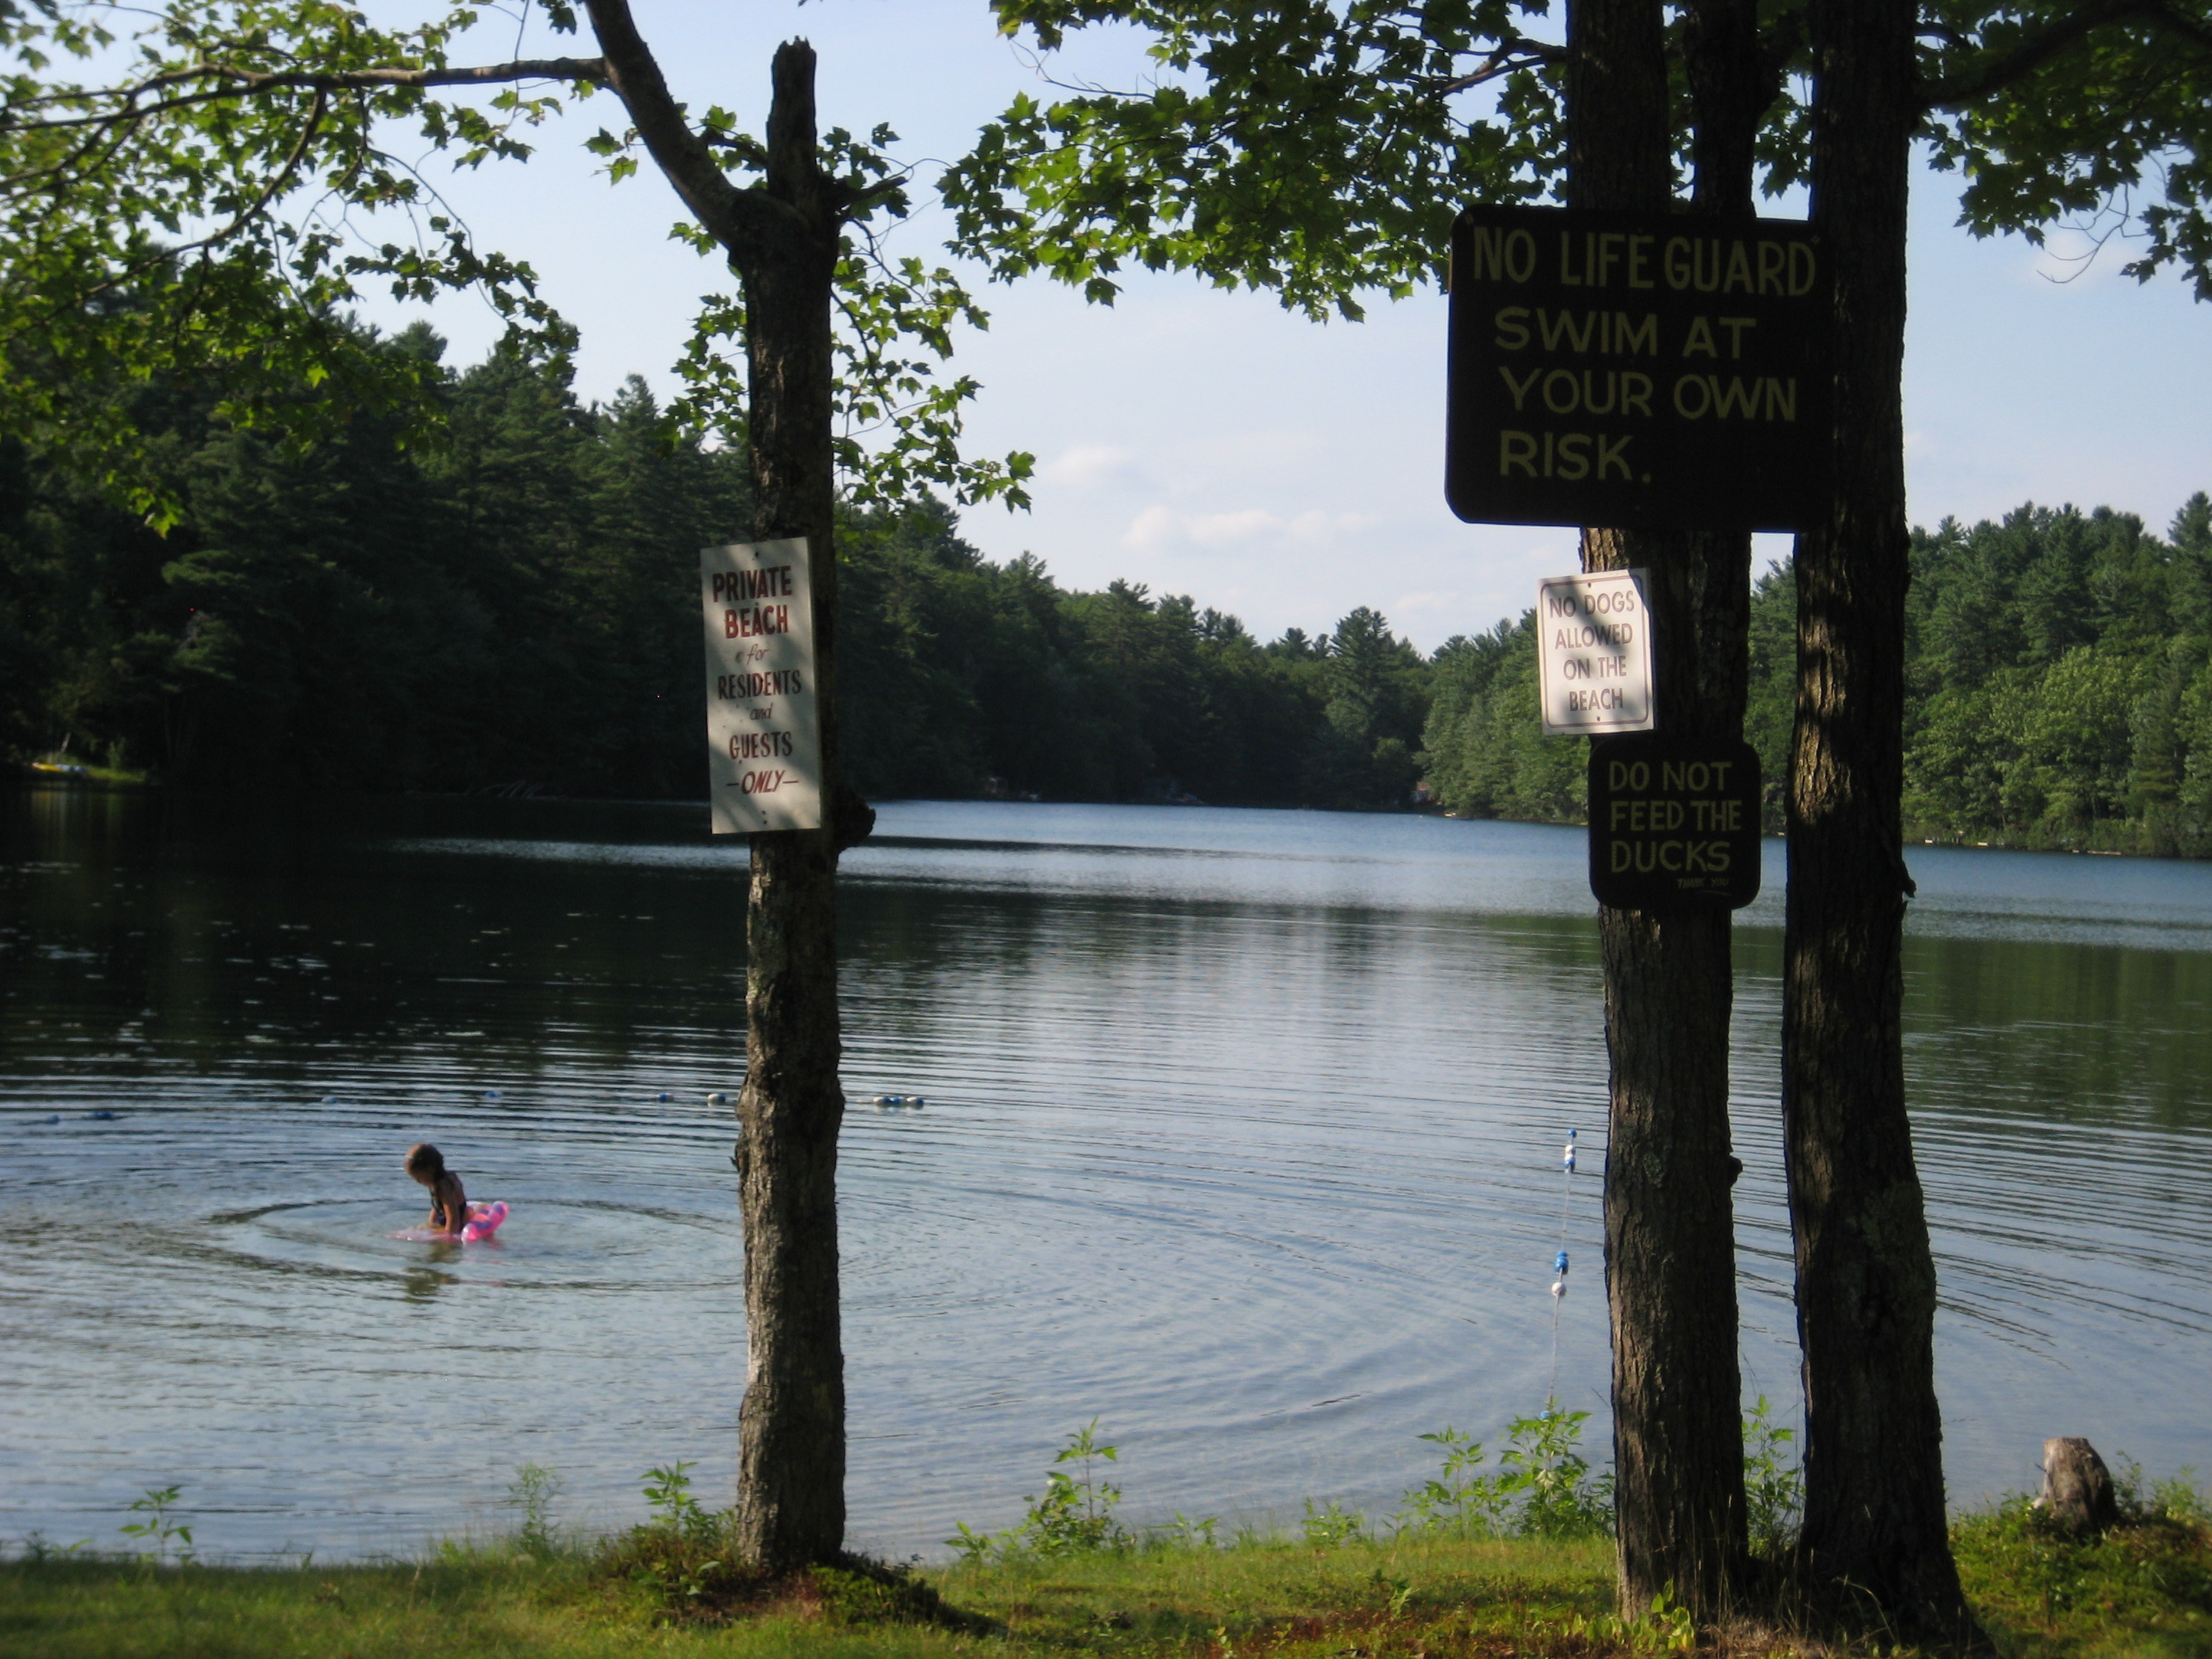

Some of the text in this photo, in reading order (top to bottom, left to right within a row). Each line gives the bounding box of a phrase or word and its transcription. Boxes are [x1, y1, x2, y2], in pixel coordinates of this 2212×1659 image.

[1473, 226, 1537, 284] NO
[1494, 306, 1756, 359] SWIM AT
[1499, 366, 1797, 421] YOUR OWN
[1499, 431, 1652, 483] RISK.
[713, 565, 792, 603] PRIVATE
[1550, 590, 1635, 618] NO DOGS
[724, 603, 788, 639] BEACH
[1555, 623, 1633, 649] ALLOWED
[746, 644, 770, 665] for
[1563, 655, 1627, 680] ON THE
[718, 670, 802, 700] RESIDENTS
[1569, 688, 1624, 712] BEACH
[750, 702, 775, 721] and
[729, 732, 793, 760] GUESTS
[1609, 761, 1732, 791] DO NOT
[1610, 800, 1742, 832] FEED THE
[1611, 840, 1730, 873] DUCKS
